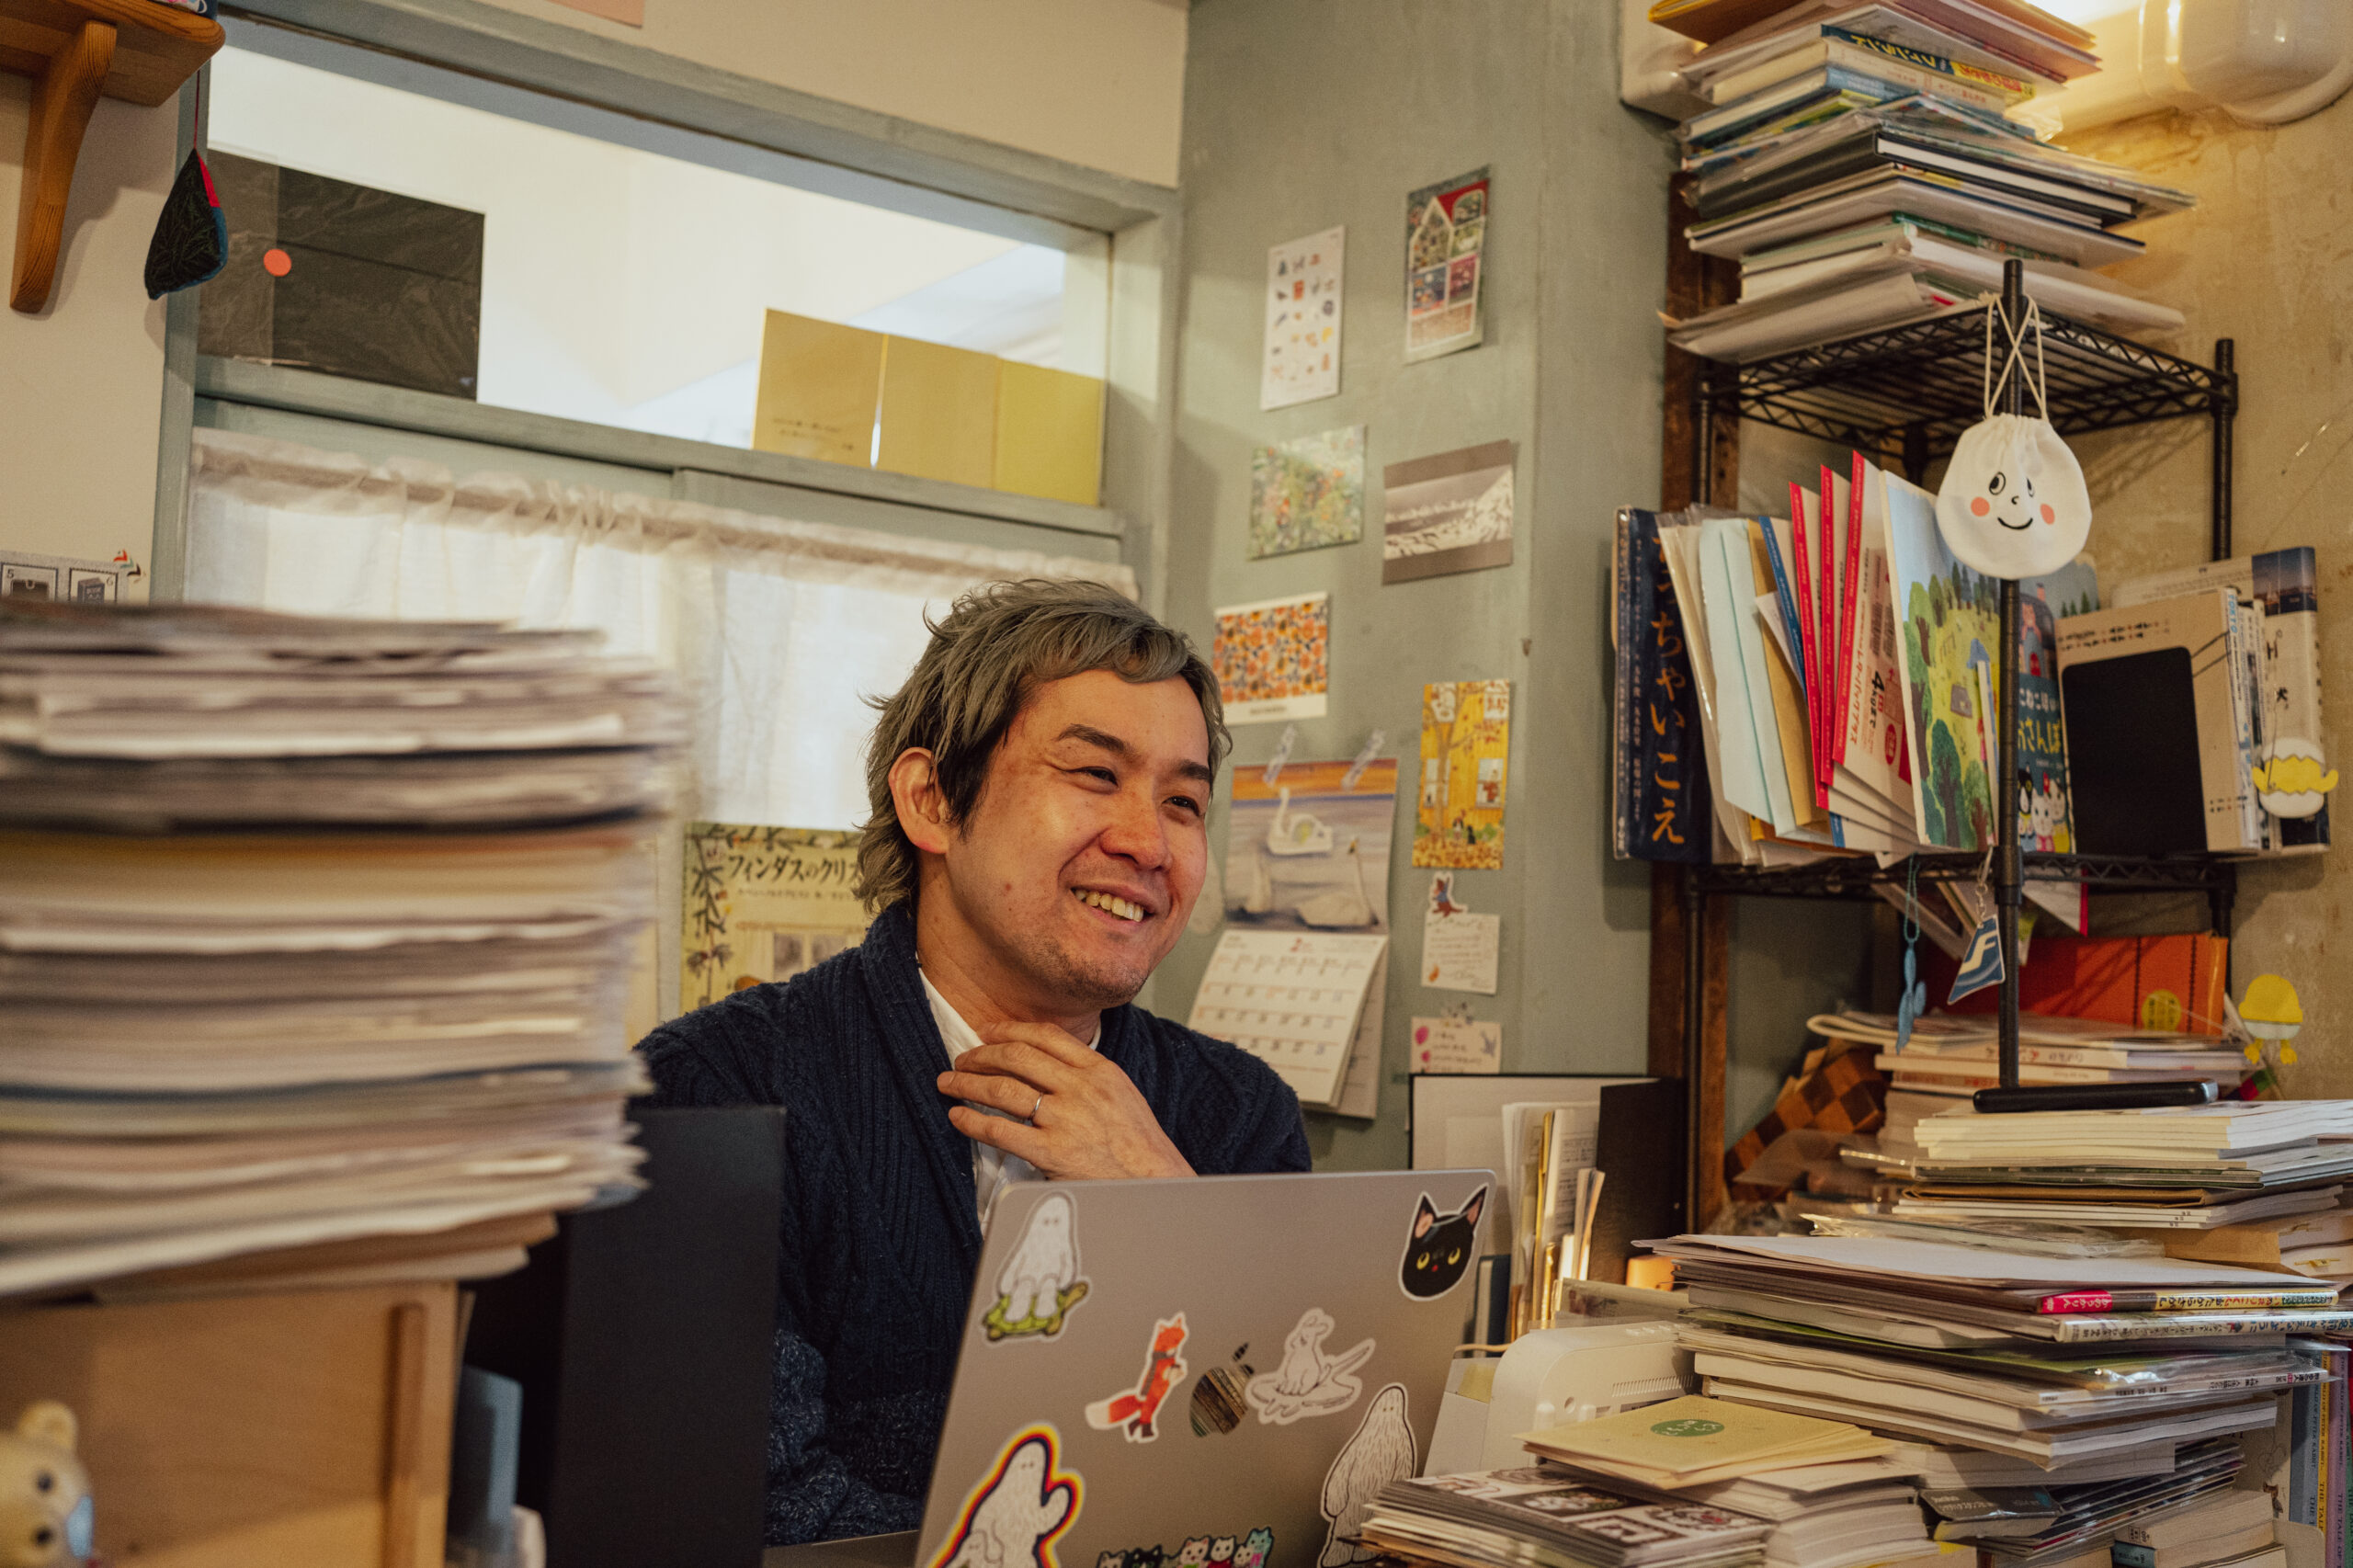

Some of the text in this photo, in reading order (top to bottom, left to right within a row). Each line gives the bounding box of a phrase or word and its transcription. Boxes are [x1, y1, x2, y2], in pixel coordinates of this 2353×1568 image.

[1850, 34, 1937, 68] フィンランド
[6, 568, 15, 579] 5
[2336, 1546, 2343, 1560] OF
